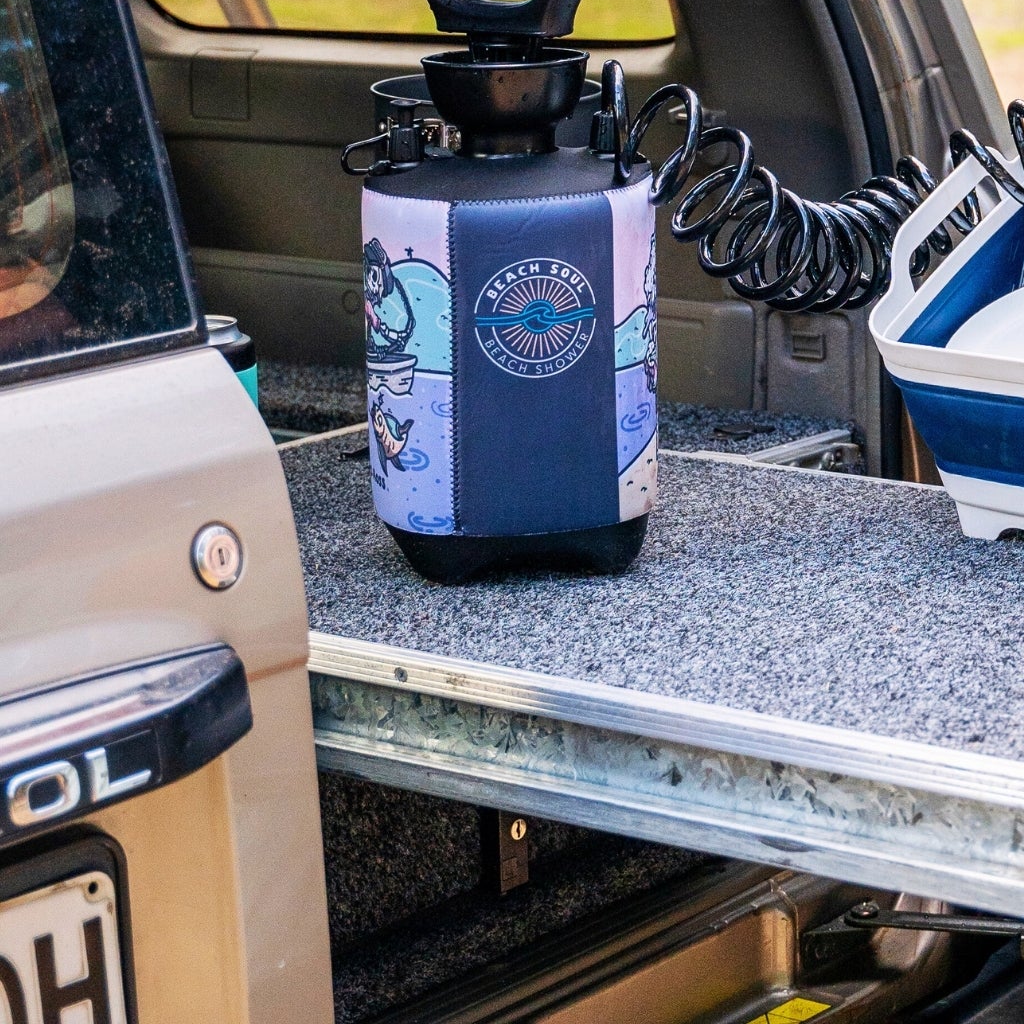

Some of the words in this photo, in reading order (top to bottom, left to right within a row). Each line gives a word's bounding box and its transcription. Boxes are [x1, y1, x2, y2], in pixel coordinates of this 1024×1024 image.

[486, 262, 540, 300] BEACH
[550, 263, 584, 293] SOUL
[484, 338, 527, 373] BEACH
[535, 332, 589, 375] SHOWER
